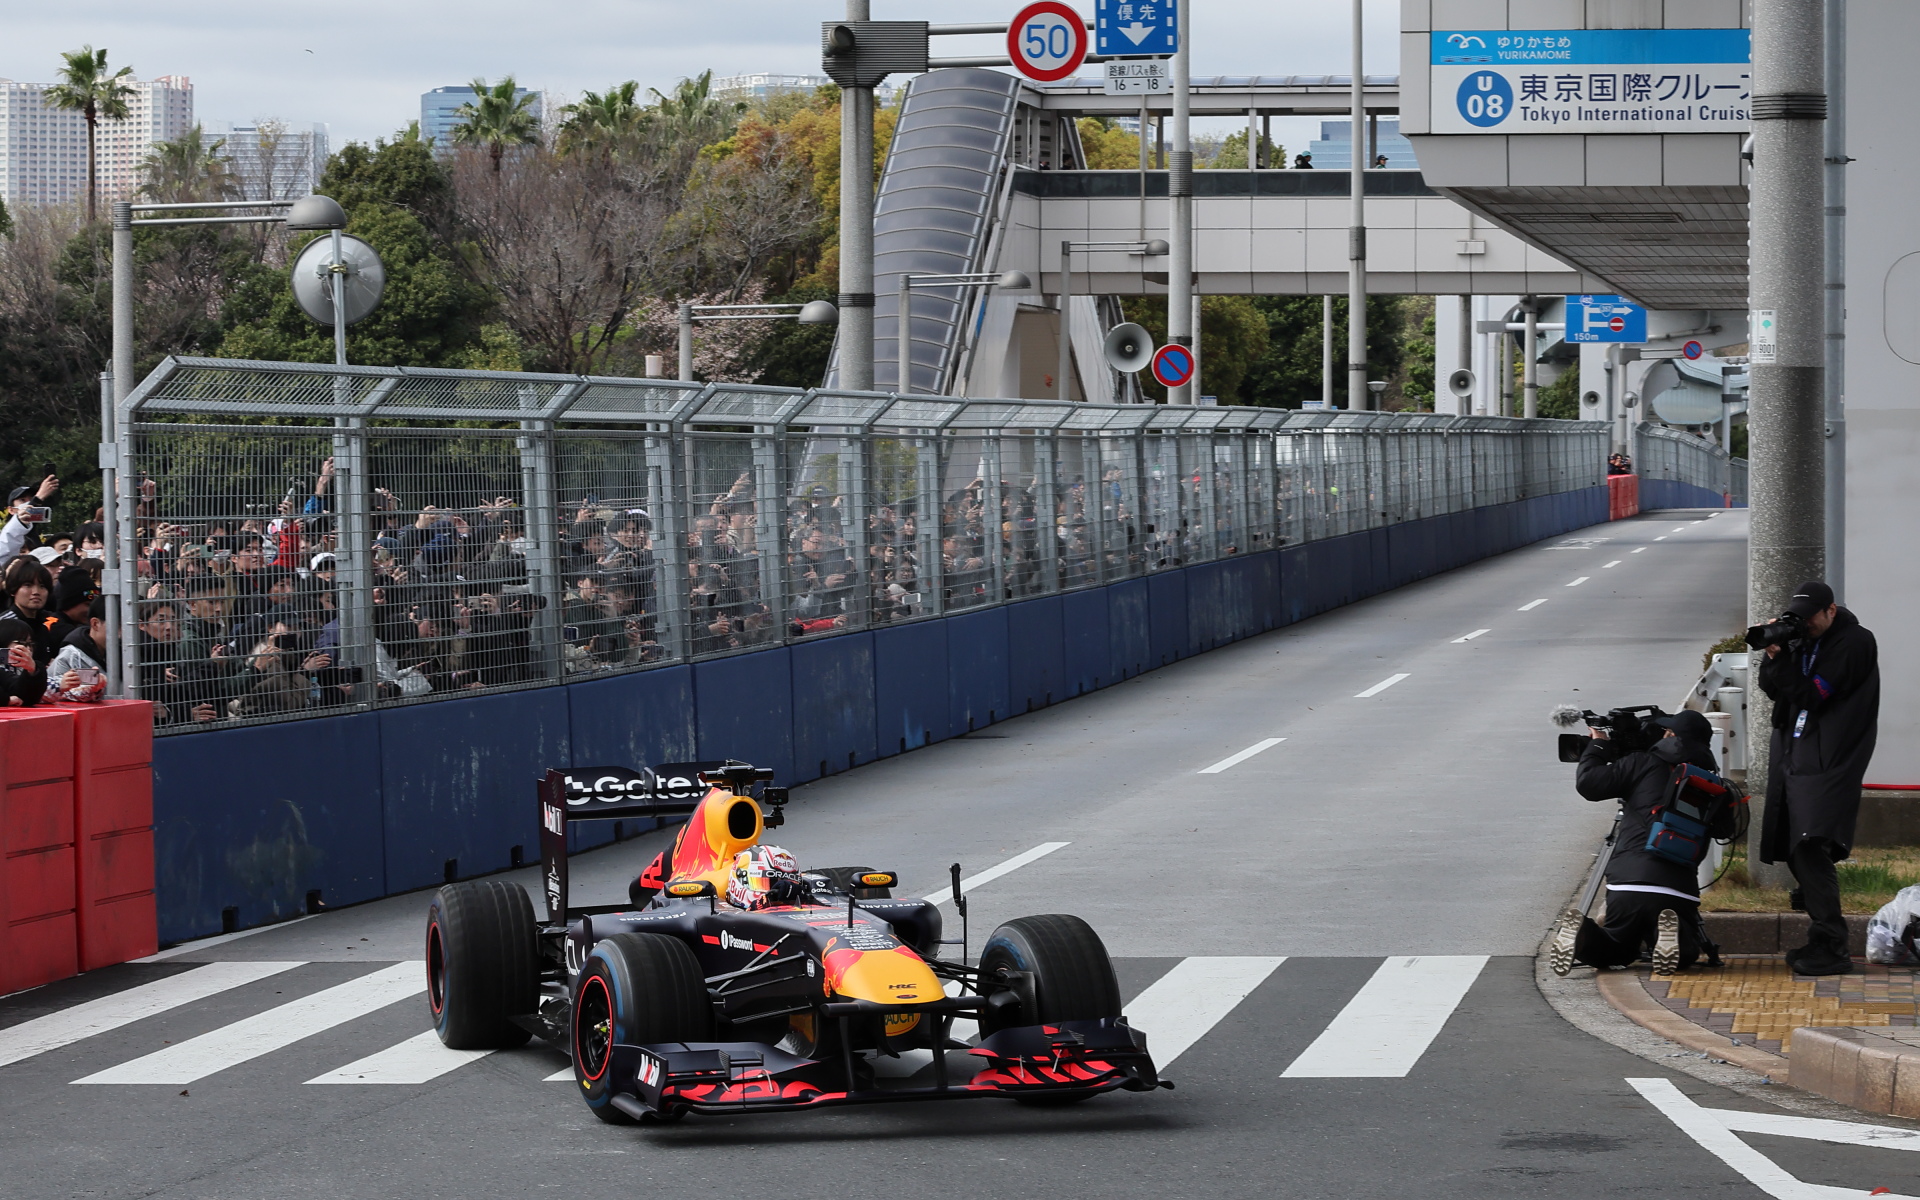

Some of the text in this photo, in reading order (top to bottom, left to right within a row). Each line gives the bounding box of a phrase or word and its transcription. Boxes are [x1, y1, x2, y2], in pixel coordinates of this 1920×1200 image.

[1117, 4, 1156, 20] 優先
[1026, 25, 1068, 58] 50
[1498, 36, 1571, 48] ゆりかもめ
[1498, 51, 1571, 59] YURIKAMOME
[1114, 79, 1127, 91] 16
[1147, 78, 1159, 90] 18
[1477, 76, 1493, 91] U
[1467, 94, 1504, 118] 08
[1520, 106, 1571, 124] Tokyo
[1578, 106, 1692, 121] International
[1574, 333, 1599, 341] 150m
[765, 870, 801, 883] ORACLE
[730, 879, 747, 902] Bull
